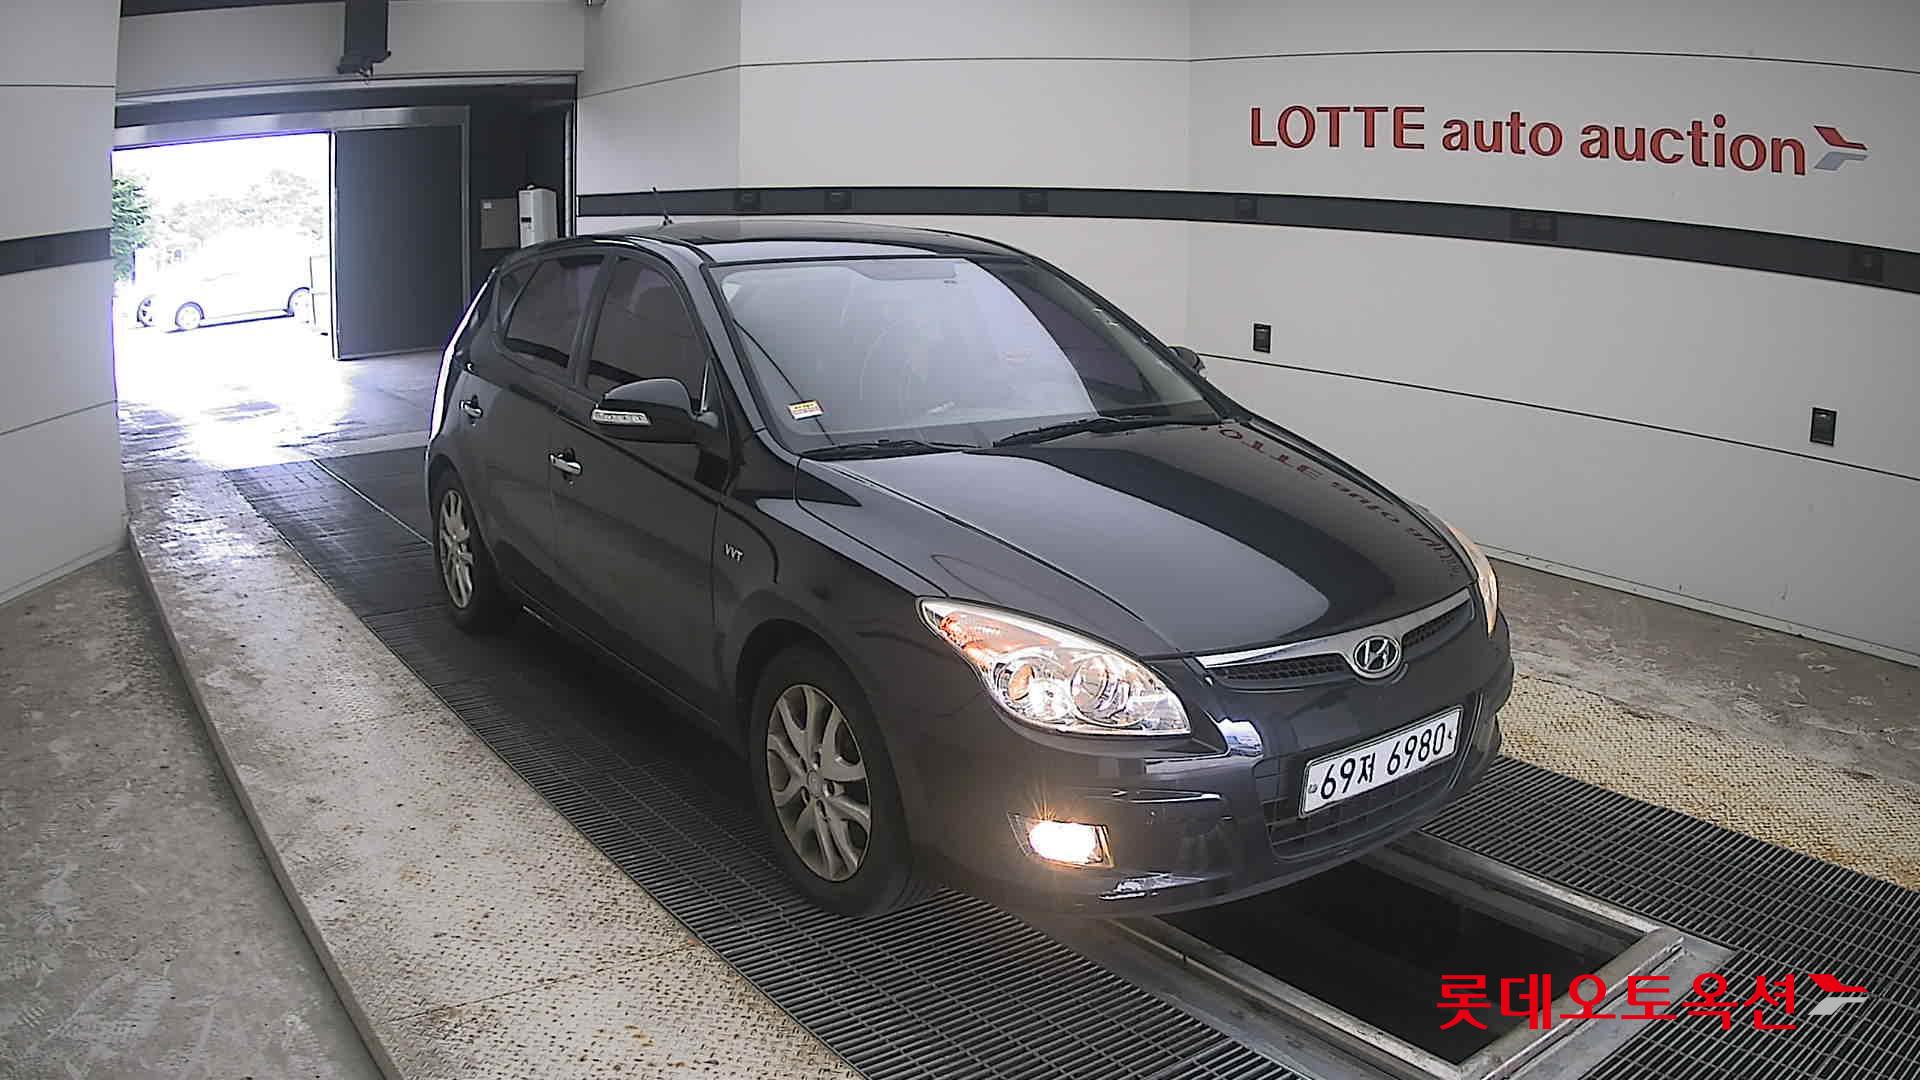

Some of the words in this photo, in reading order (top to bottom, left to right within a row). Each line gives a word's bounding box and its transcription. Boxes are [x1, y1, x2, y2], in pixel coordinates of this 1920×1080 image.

[1250, 105, 1425, 150] LOTTE
[1442, 111, 1564, 156] auto
[1579, 114, 1806, 175] auction
[1320, 752, 1376, 800] 69저
[1386, 722, 1446, 776] 6980
